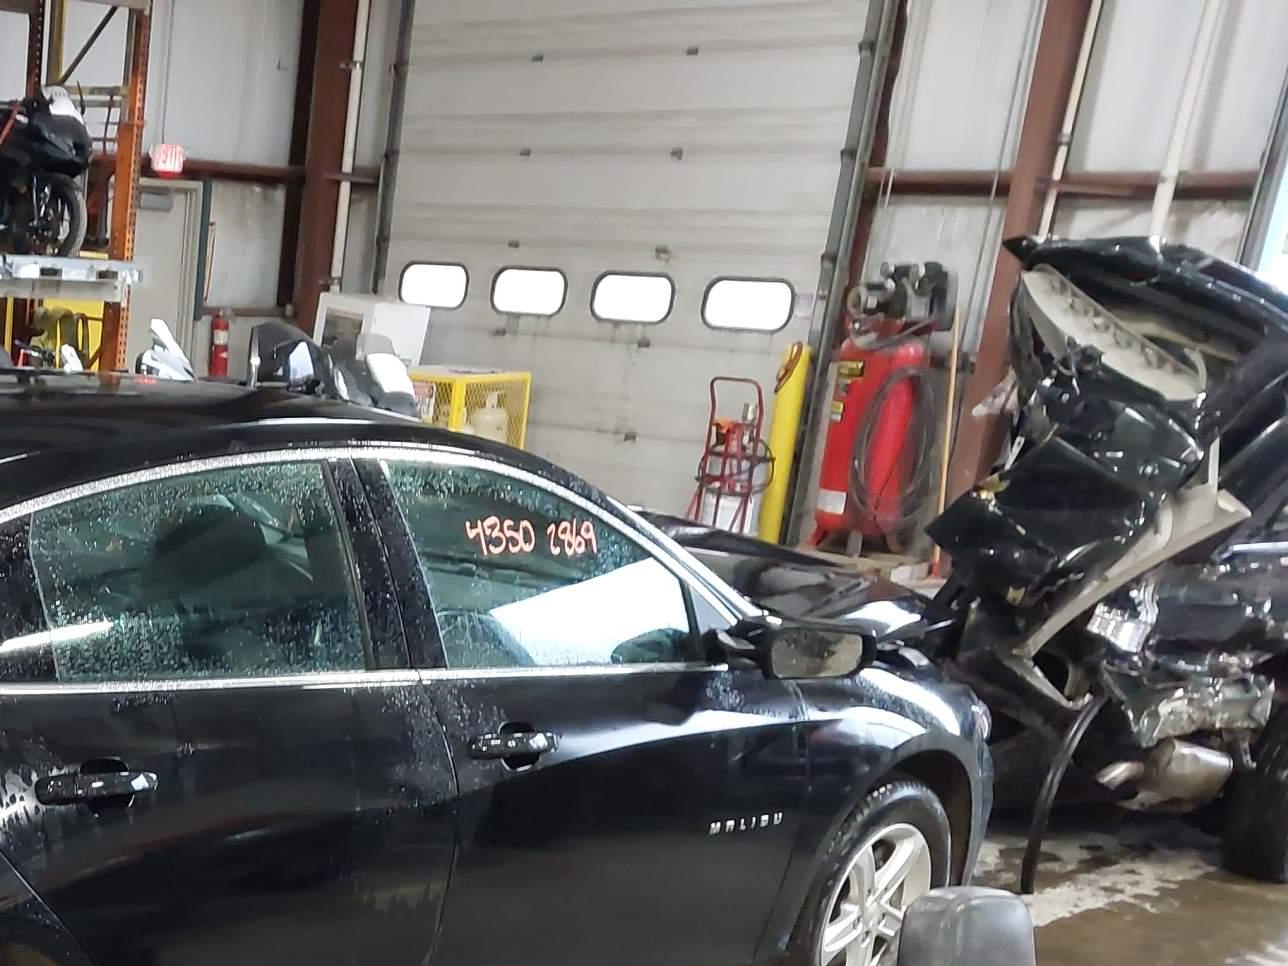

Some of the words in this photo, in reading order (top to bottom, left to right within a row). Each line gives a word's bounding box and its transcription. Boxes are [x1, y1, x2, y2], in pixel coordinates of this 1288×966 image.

[465, 515, 535, 556] 4350
[546, 517, 597, 556] 2869
[709, 812, 783, 835] MALIBU
